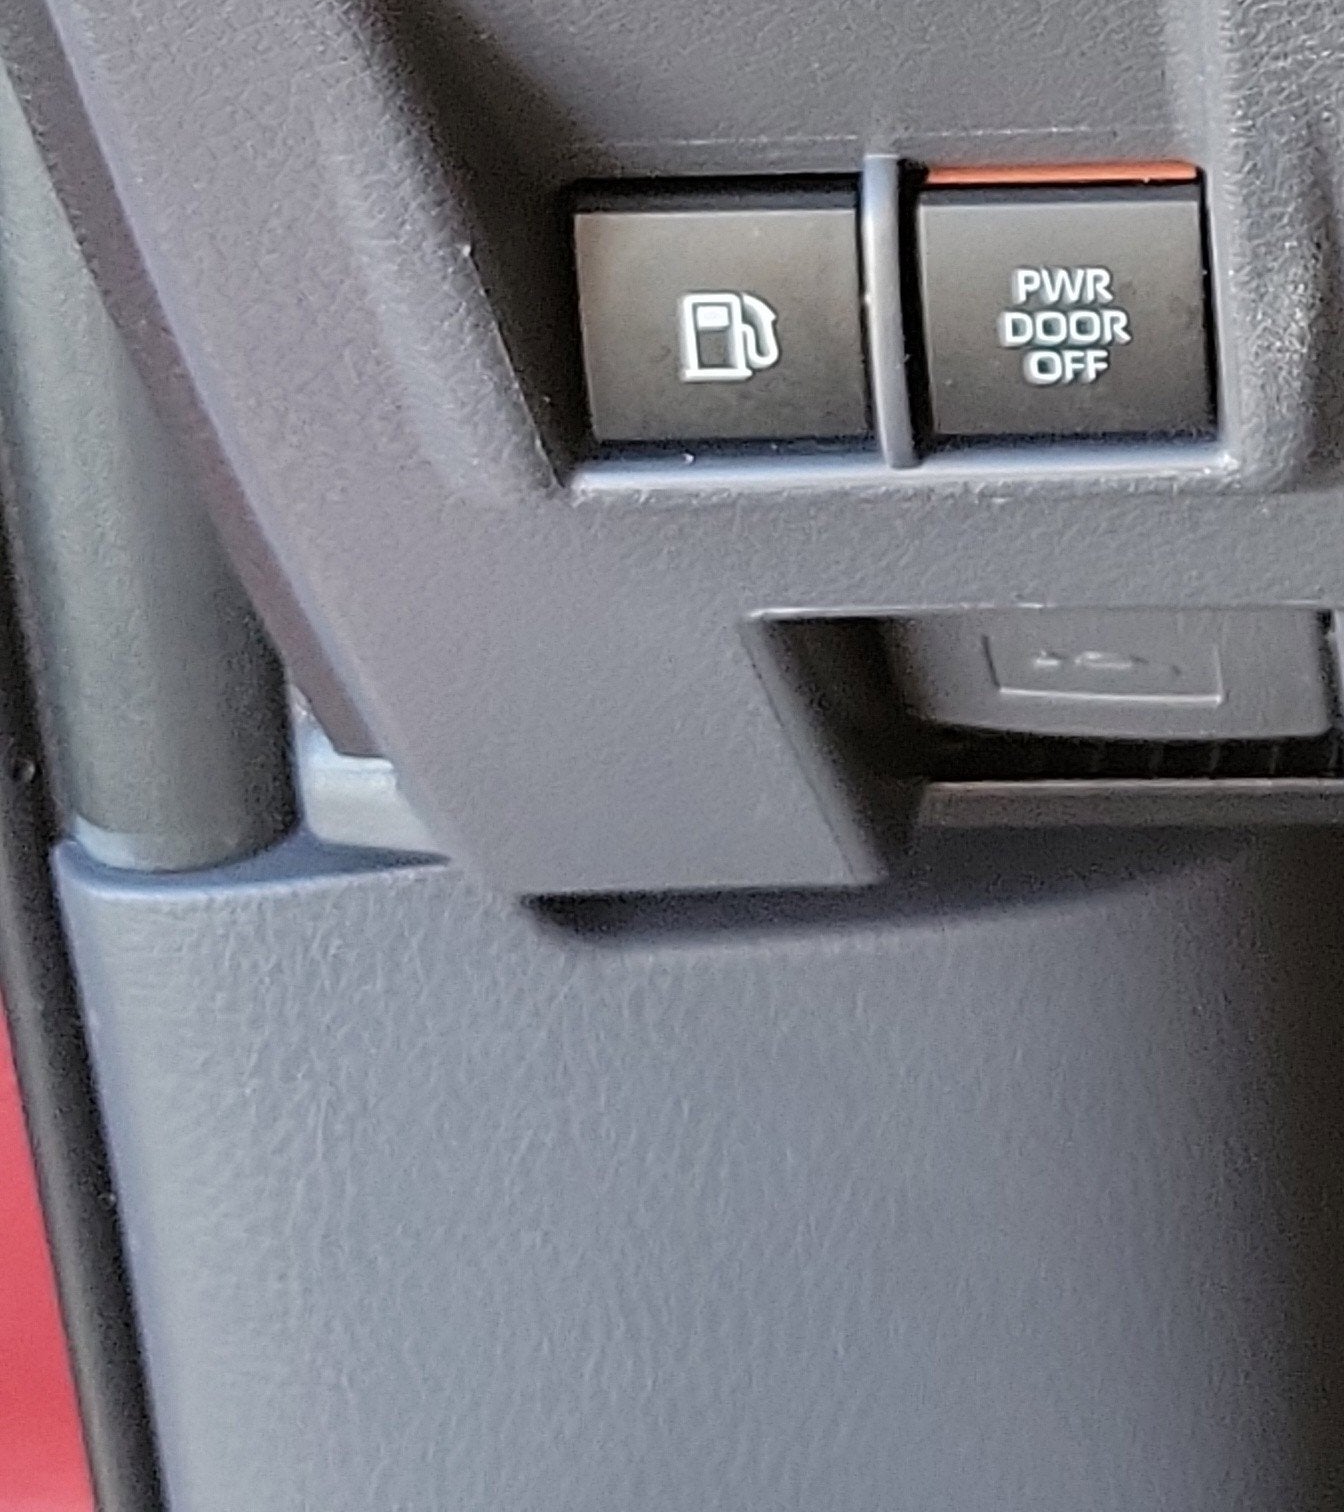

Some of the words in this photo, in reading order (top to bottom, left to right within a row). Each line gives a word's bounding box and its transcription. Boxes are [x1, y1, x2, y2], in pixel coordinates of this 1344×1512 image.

[1012, 268, 1113, 304] PWR
[1000, 309, 1132, 347] DOOR
[1024, 349, 1109, 384] OFF
